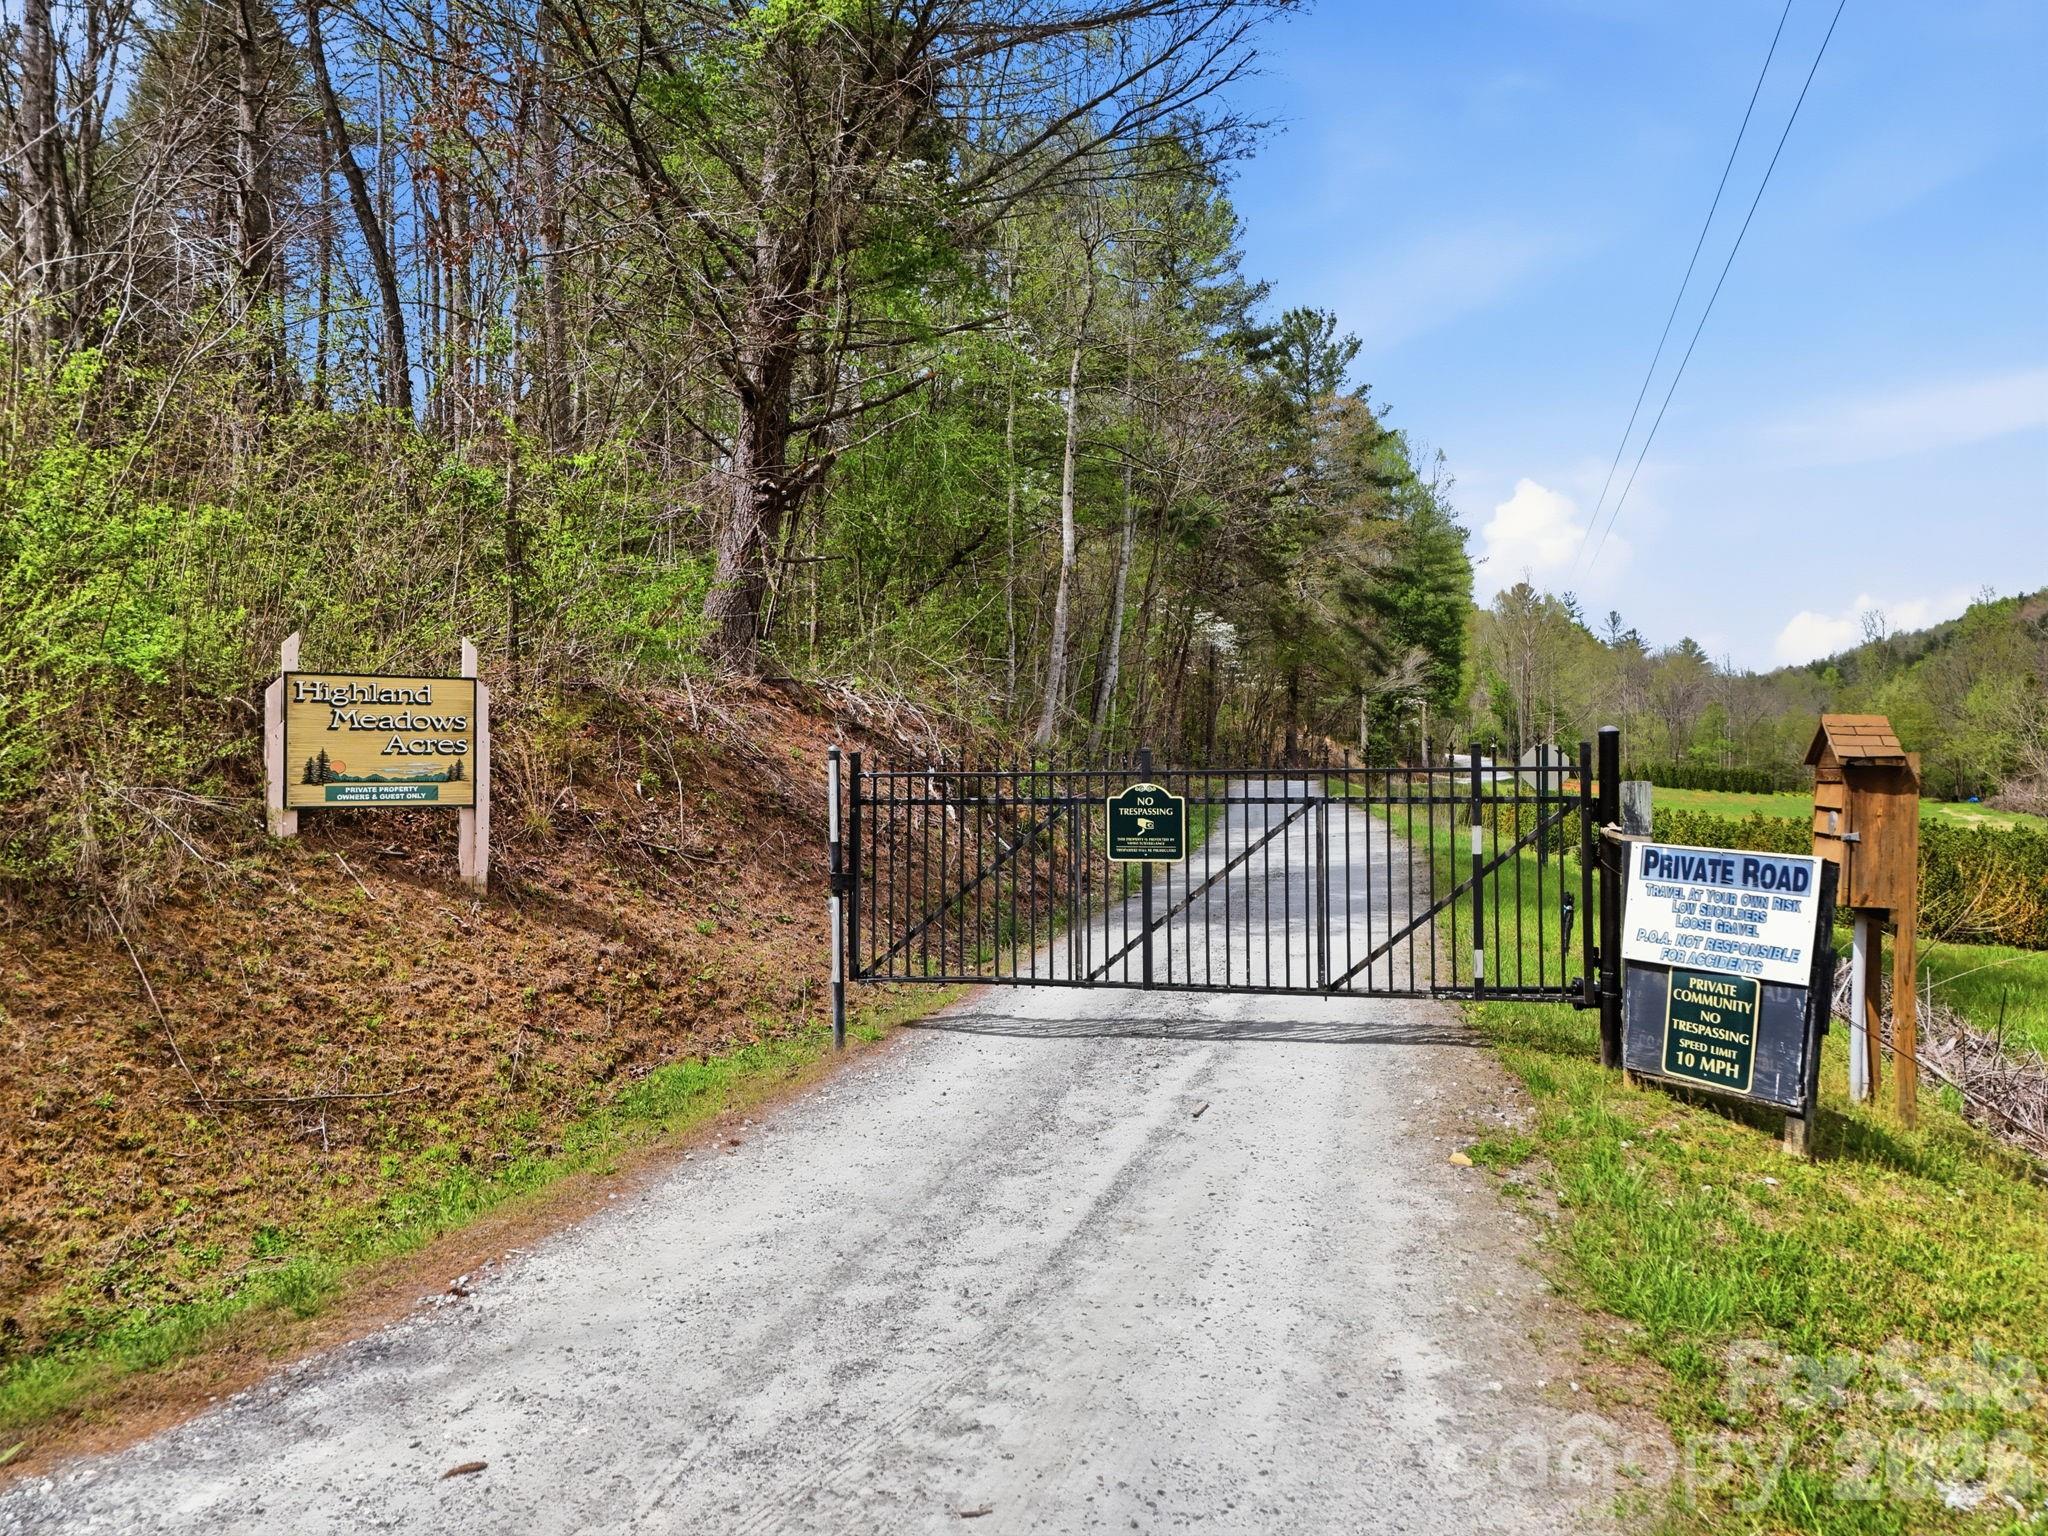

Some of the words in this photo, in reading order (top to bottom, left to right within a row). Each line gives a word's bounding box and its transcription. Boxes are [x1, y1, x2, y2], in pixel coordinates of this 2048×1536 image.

[294, 680, 432, 706] Highland
[329, 708, 467, 730] Meadows
[382, 734, 468, 755] Acres
[1119, 807, 1173, 816] TRESPASSING
[1137, 797, 1154, 806] NO
[1772, 896, 1802, 913] RISK
[1636, 928, 1672, 946] P.O.A.
[1675, 933, 1703, 949] NOT
[1704, 938, 1800, 963] RESPONSIBLE
[1660, 948, 1685, 963] FOR
[1688, 953, 1763, 975] ACCIDENTS
[1689, 977, 1737, 997] PRIVATE
[1673, 988, 1752, 1014] COMMUNITY
[1700, 1010, 1721, 1024] NO
[1672, 1018, 1749, 1045] TRESPASSING
[1679, 1038, 1708, 1052] SPEED
[1710, 1045, 1737, 1059] LIMIT
[1676, 1051, 1695, 1067] 10
[1700, 1056, 1739, 1079] MPH
